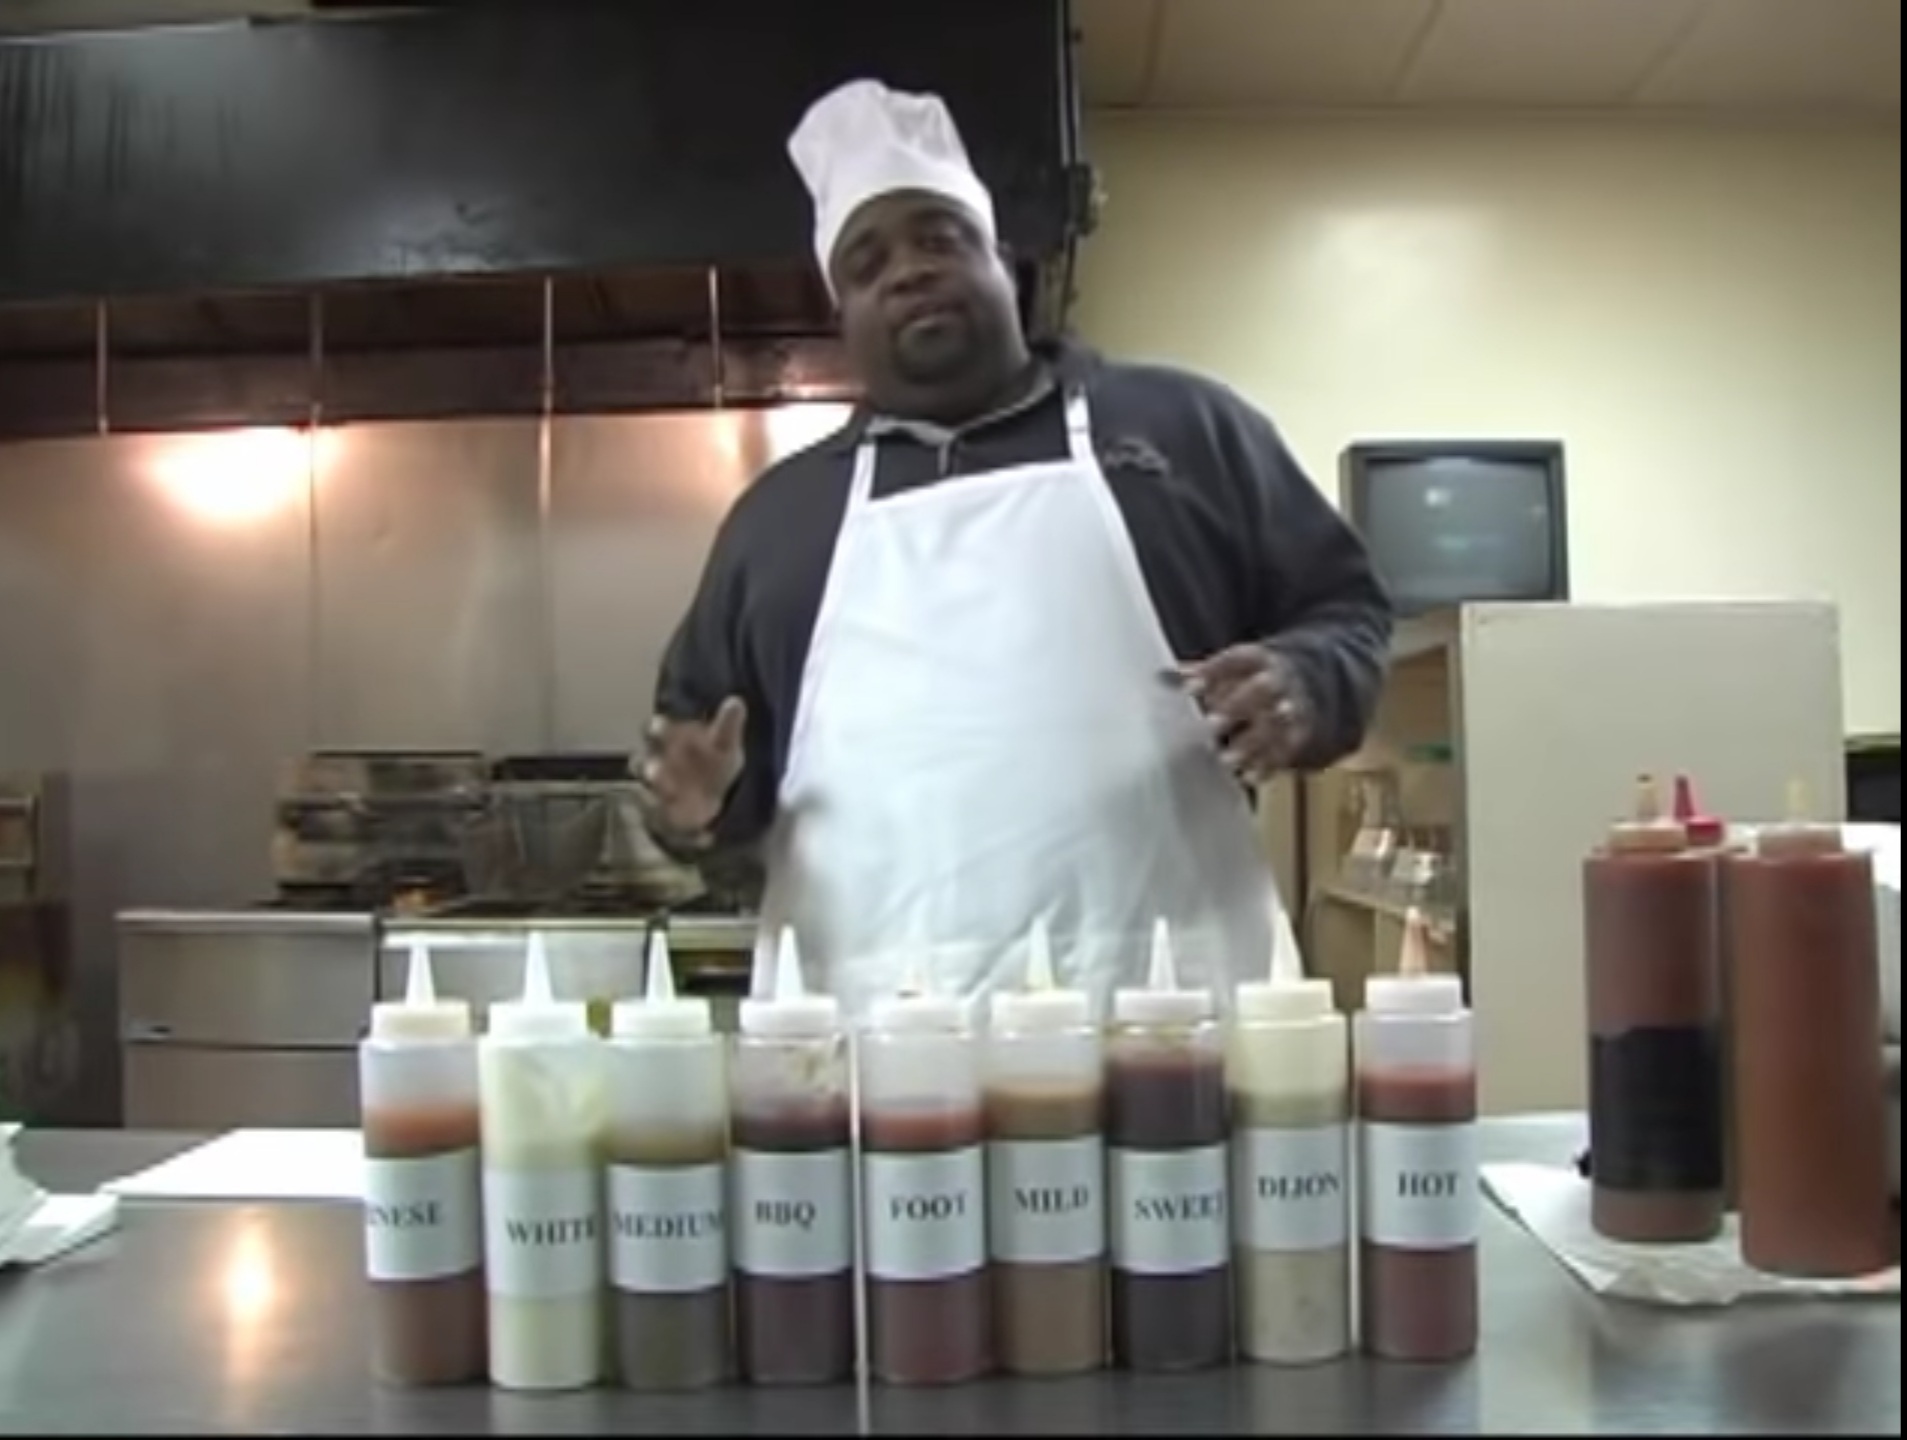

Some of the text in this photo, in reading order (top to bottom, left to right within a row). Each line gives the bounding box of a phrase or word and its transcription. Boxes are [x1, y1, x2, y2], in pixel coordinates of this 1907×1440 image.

[1013, 1184, 1090, 1214] MILD
[1257, 1171, 1341, 1201] DIJON
[1397, 1170, 1458, 1198] HOT
[754, 1200, 816, 1232] BBQ
[888, 1189, 967, 1222] FOOT
[612, 1209, 724, 1239] MEDIUM
